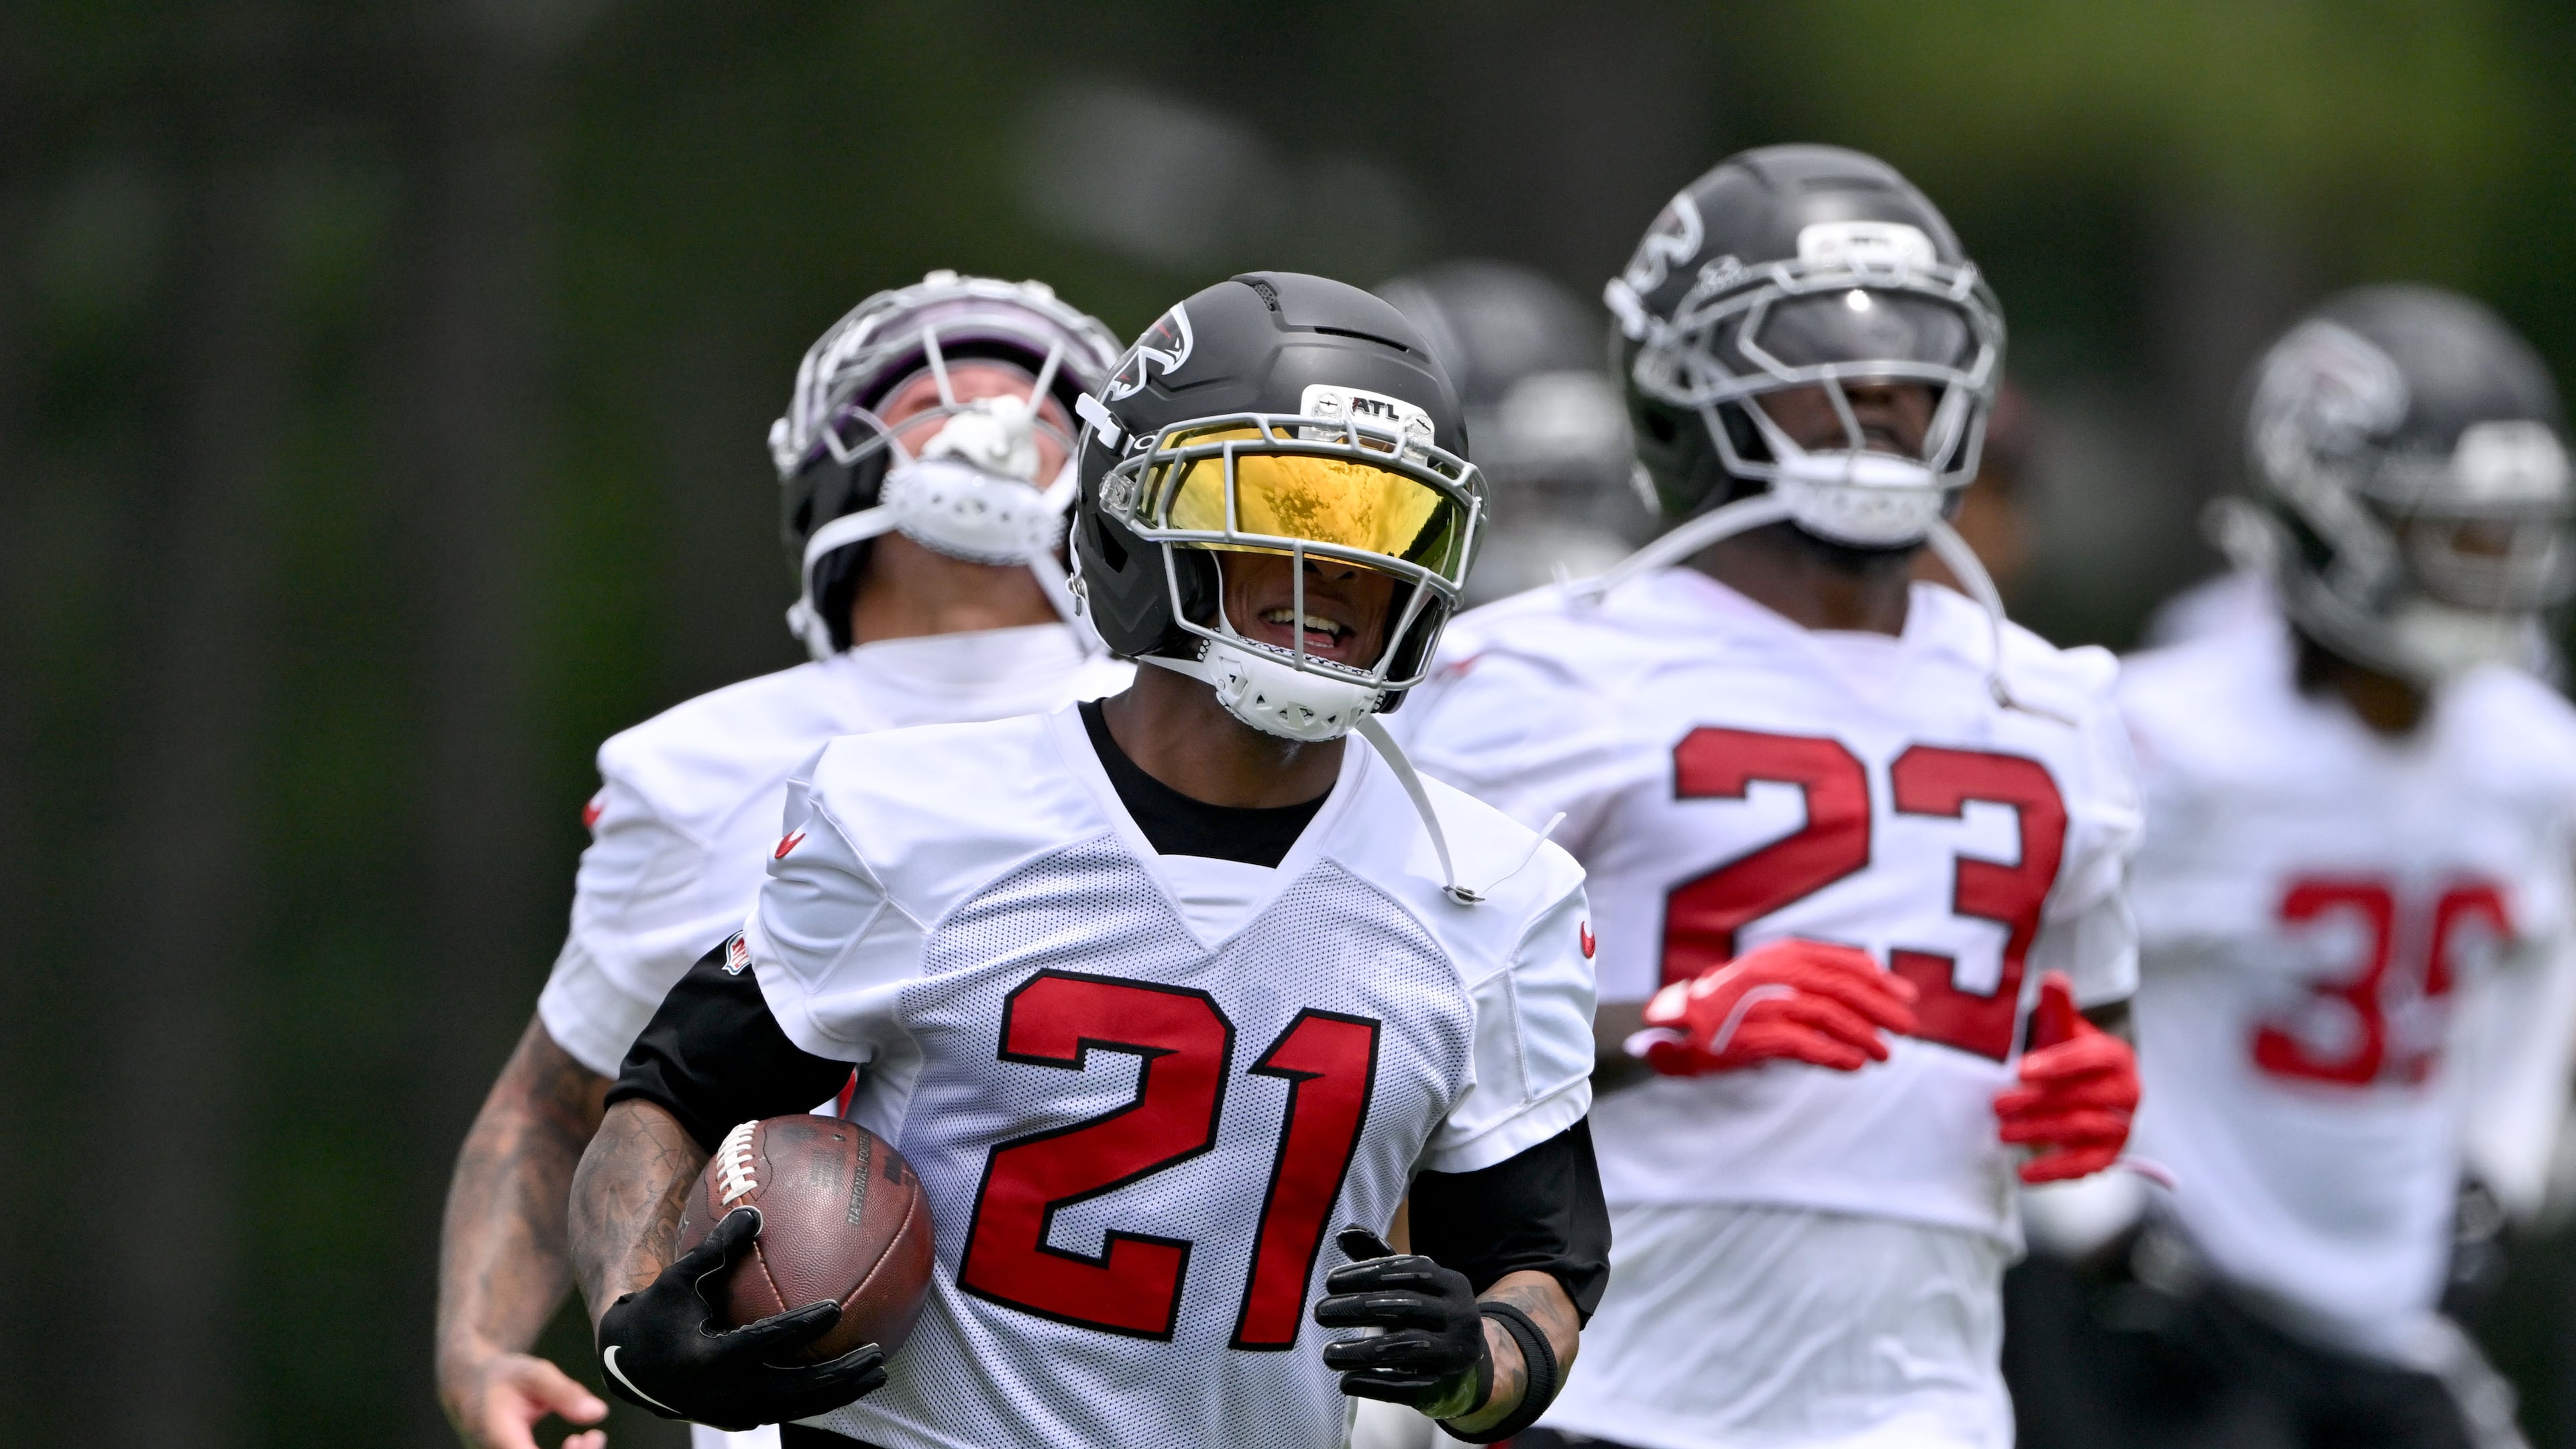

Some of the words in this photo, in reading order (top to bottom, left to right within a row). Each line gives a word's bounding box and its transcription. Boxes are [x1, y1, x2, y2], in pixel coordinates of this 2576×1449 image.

[1352, 397, 1400, 421] ATL
[1659, 726, 2068, 1065] 23
[847, 1167, 867, 1225] NATIONAL
[956, 967, 1381, 1350] 21
